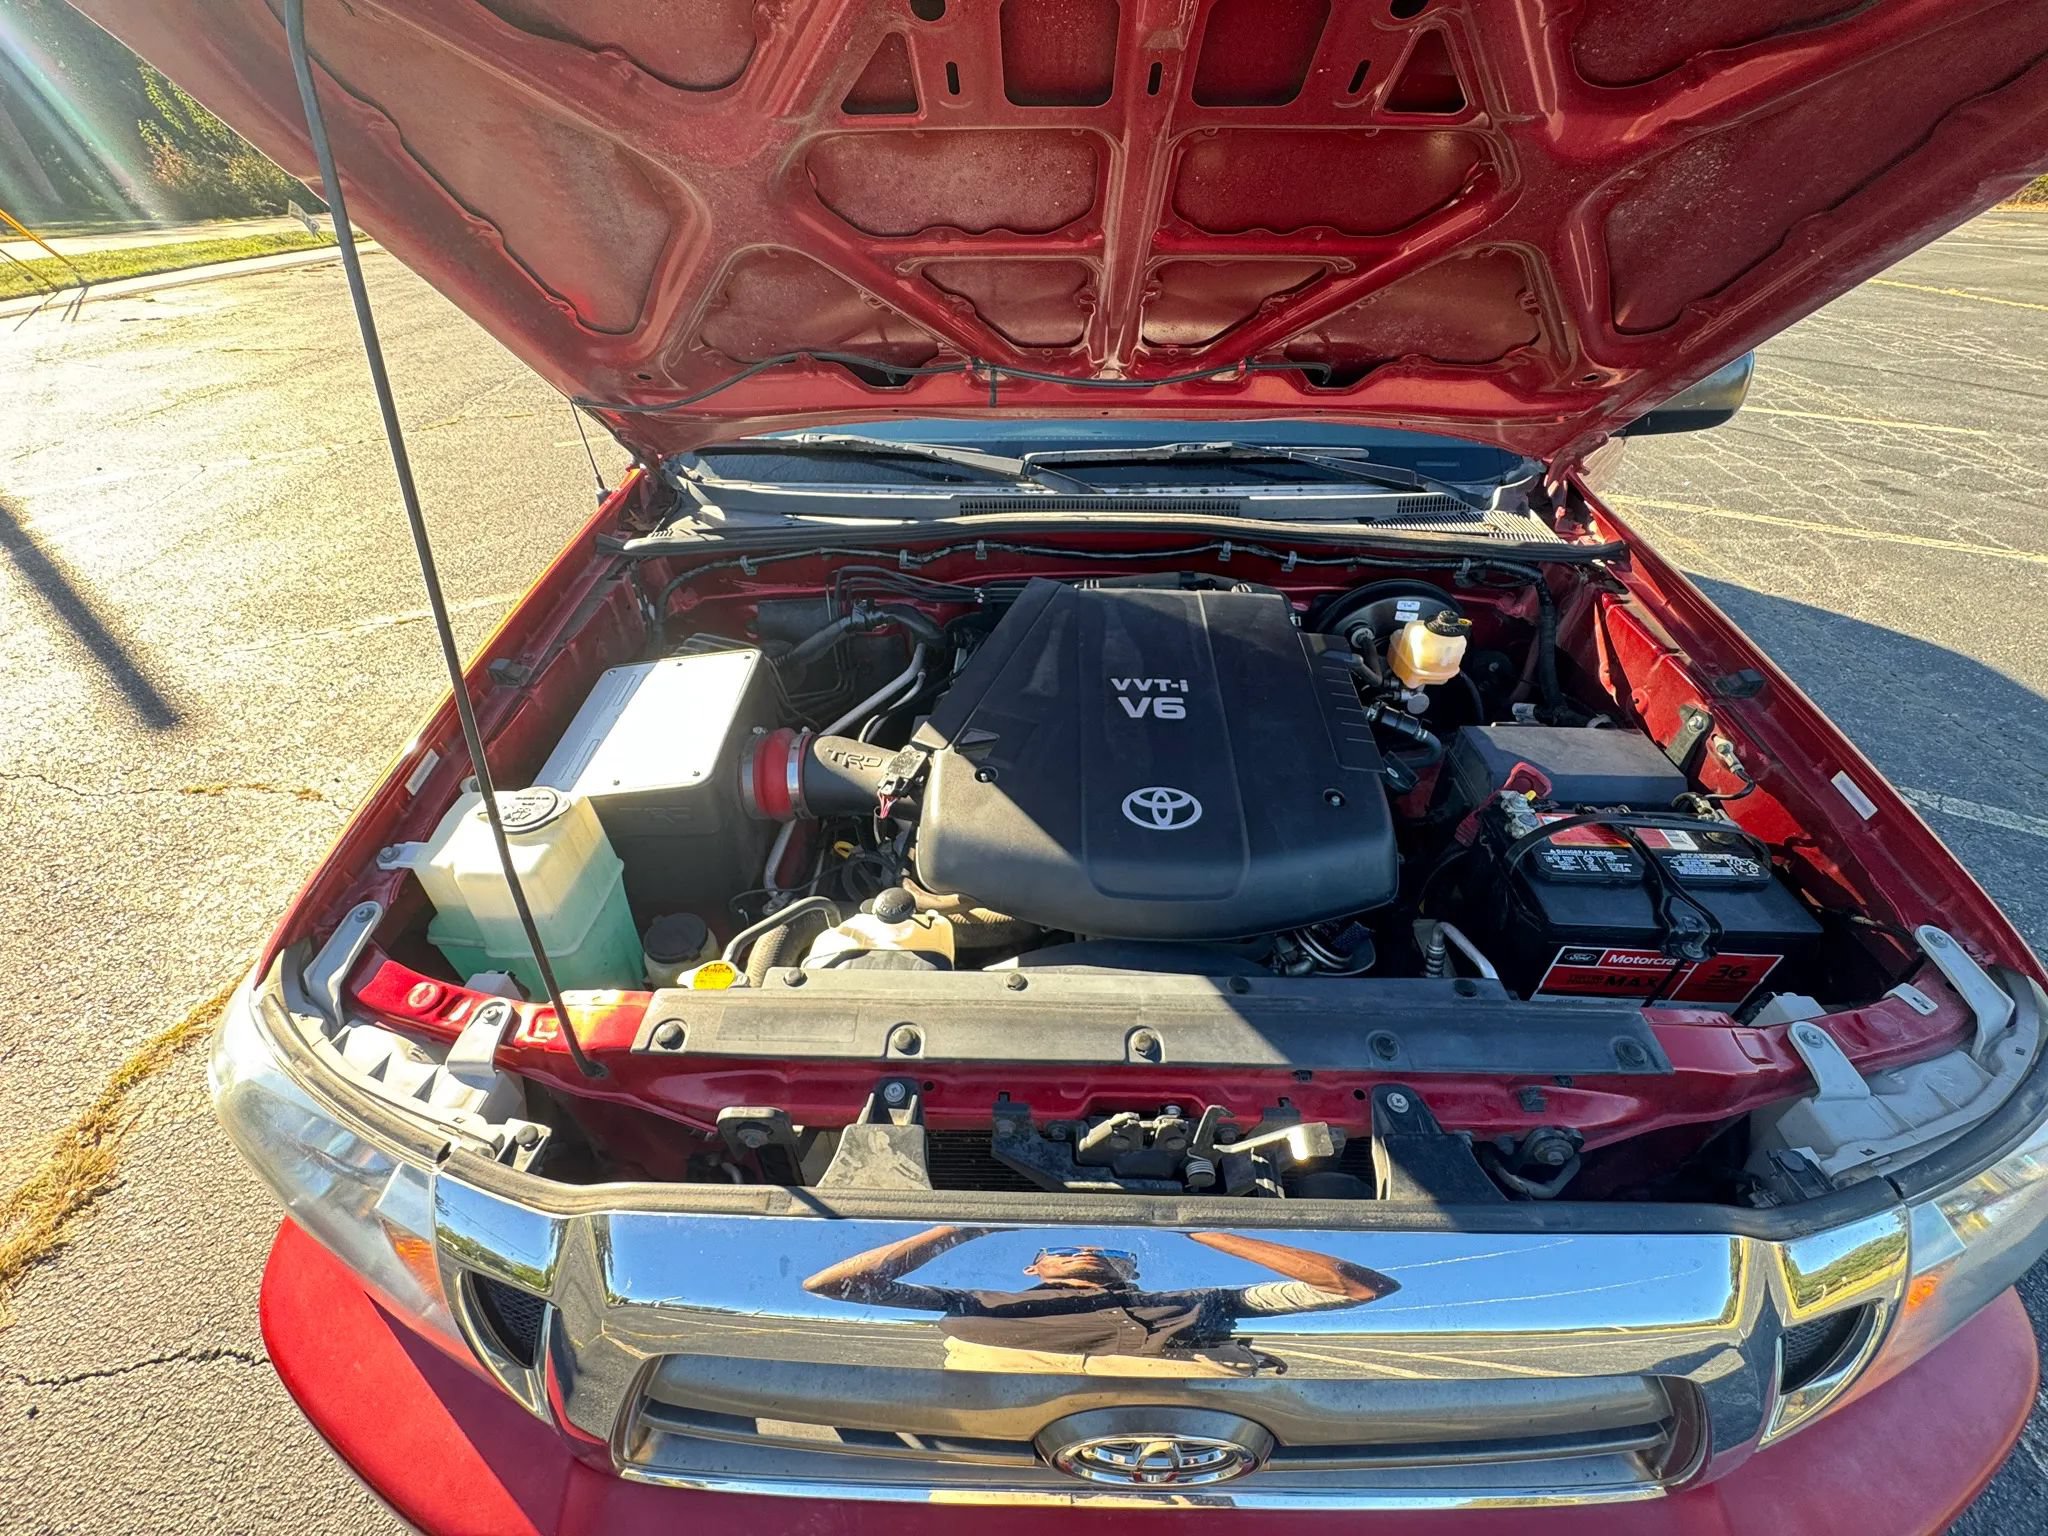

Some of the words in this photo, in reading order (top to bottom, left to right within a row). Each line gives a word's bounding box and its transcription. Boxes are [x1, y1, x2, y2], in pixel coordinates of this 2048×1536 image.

[1110, 677, 1189, 693] VVT-i
[1117, 696, 1187, 720] V6
[826, 746, 884, 770] TRD
[1608, 954, 1687, 967] Motorcra
[1708, 964, 1750, 979] 36
